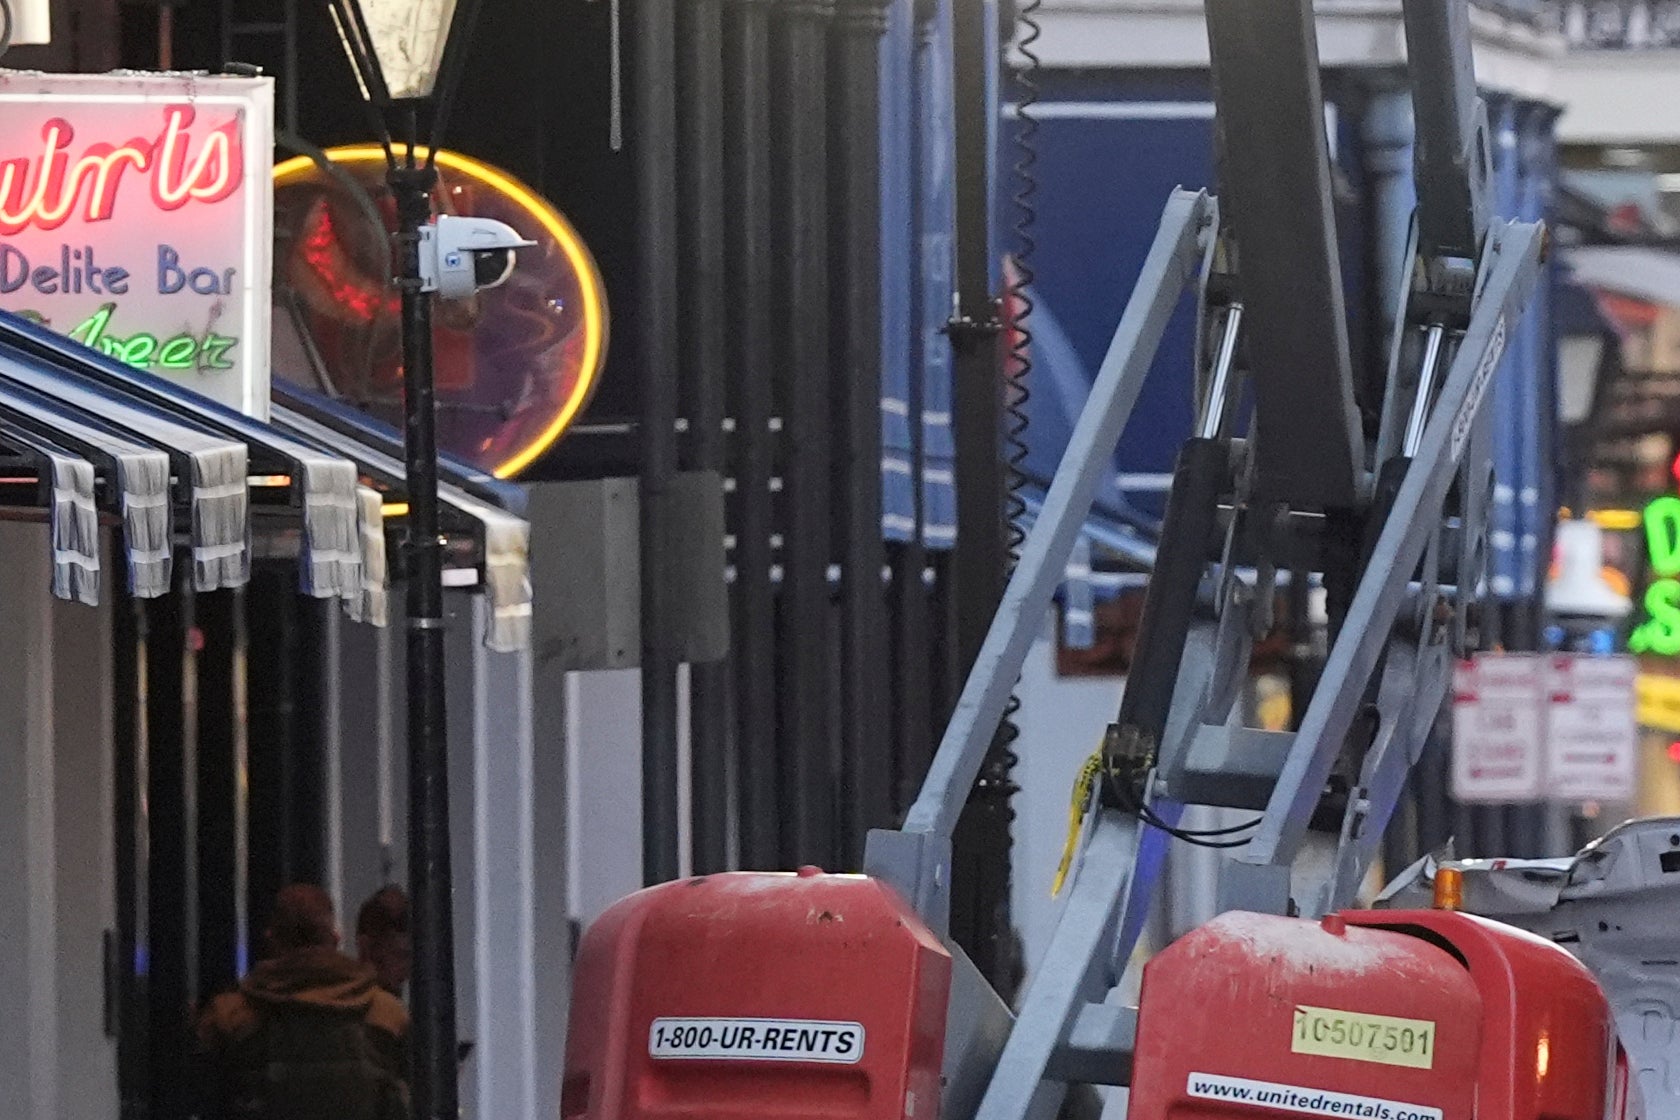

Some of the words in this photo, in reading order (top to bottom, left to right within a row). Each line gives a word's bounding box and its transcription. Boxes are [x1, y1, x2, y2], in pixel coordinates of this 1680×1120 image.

[0, 243, 130, 294] Delite
[157, 243, 236, 295] Bar
[656, 1026, 854, 1054] 1-800-UR-RENTS
[1296, 1016, 1429, 1055] 10507501
